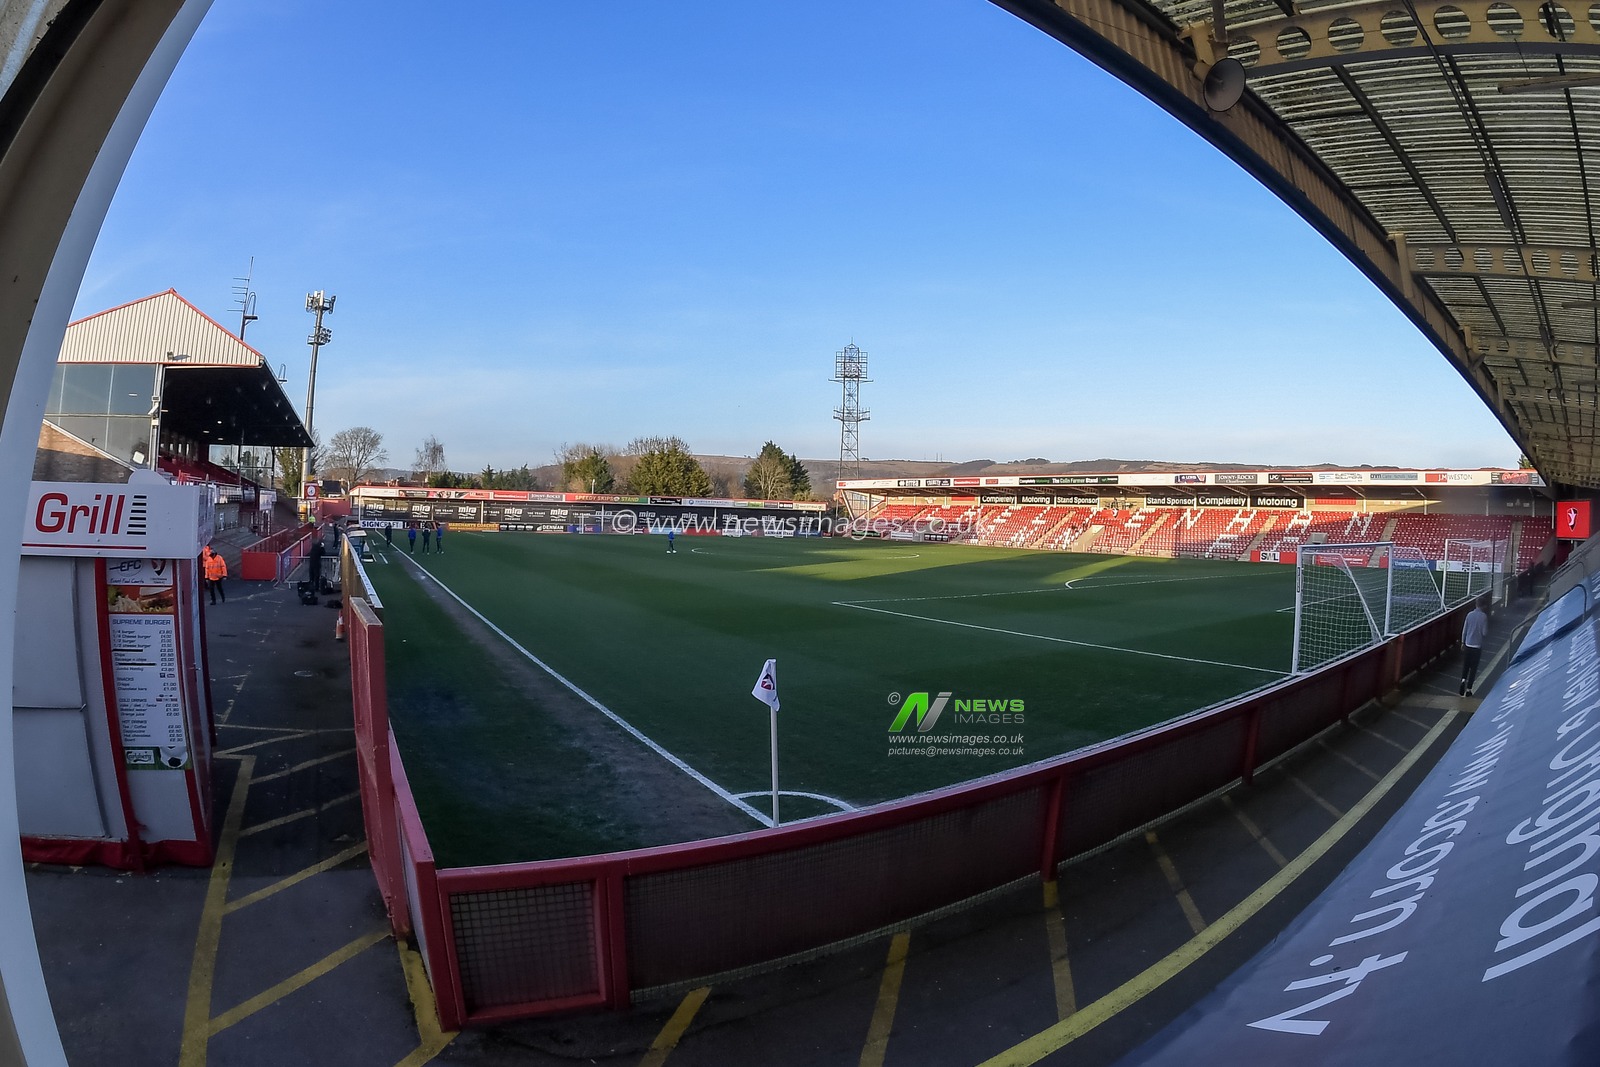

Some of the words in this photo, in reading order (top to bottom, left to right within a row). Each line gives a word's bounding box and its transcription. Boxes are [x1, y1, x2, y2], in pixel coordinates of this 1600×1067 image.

[982, 496, 1016, 504] Completely
[1021, 496, 1051, 504] Motoring
[1167, 497, 1195, 505] Sponsor
[1198, 496, 1246, 506] Completely
[1257, 496, 1298, 507] Motoring
[412, 504, 431, 512] mira
[458, 506, 477, 514] mira
[505, 507, 523, 515] mira
[550, 508, 568, 516] mira
[35, 493, 125, 535] Grill
[119, 560, 142, 571] EFC
[1482, 721, 1600, 983] Original
[1246, 724, 1515, 1036] www.acorn.tv
